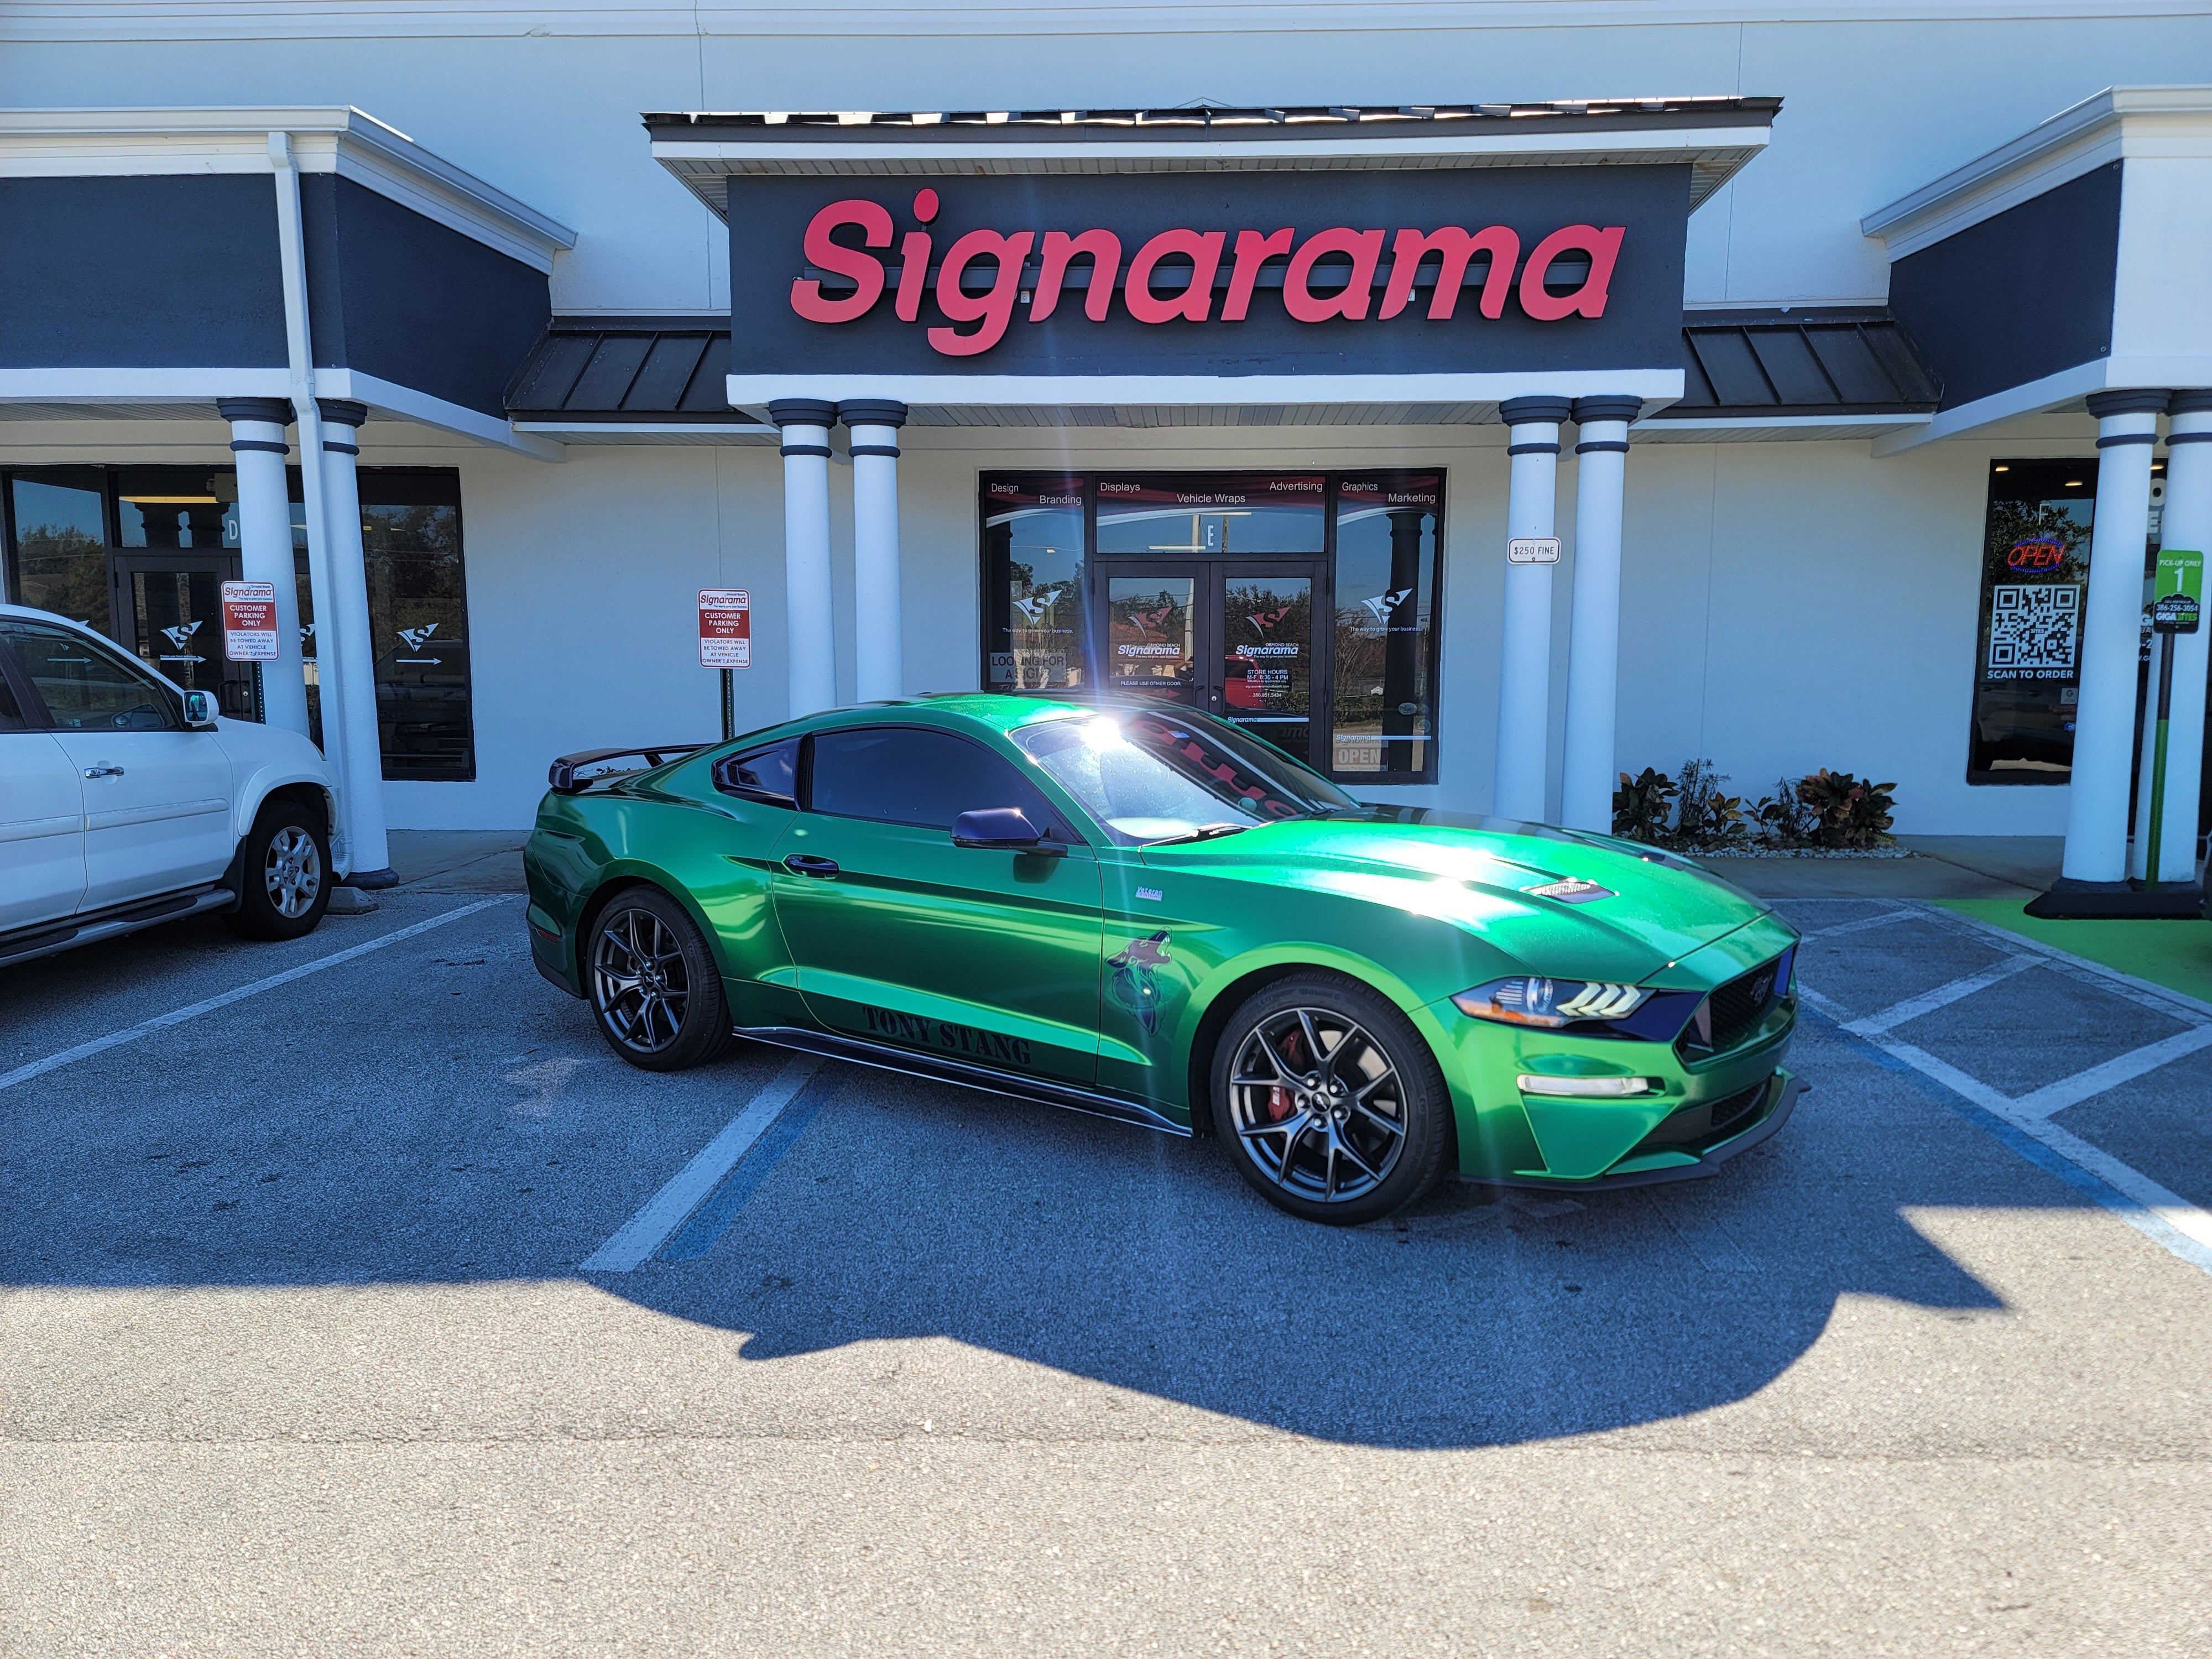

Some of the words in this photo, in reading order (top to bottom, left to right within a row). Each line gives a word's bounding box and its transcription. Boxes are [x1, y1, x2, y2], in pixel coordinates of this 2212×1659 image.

[790, 187, 1626, 356] Signarama
[991, 483, 1019, 494] Design
[1100, 482, 1141, 493] Displays
[1269, 481, 1323, 493] Advertising
[1342, 482, 1379, 493] Graphics
[1039, 495, 1082, 506] Branding
[1177, 494, 1212, 503] Vehicle
[1214, 494, 1246, 505] Wraps
[1388, 493, 1436, 504] Marketing
[2038, 503, 2051, 525] F
[228, 520, 238, 540] D
[1207, 525, 1214, 546] E
[1514, 546, 1535, 555] $250
[1538, 546, 1554, 555] FINE
[2007, 545, 2065, 566] OPEN
[2174, 567, 2183, 592] 1
[225, 587, 272, 598] Signarama
[700, 595, 746, 606] Signarama
[2156, 612, 2176, 621] GIGA
[1118, 644, 1180, 657] Signarama
[1235, 644, 1298, 657] Signarama
[1043, 656, 1064, 666] FOR
[1005, 669, 1013, 679] A
[1987, 670, 2017, 679] SCAN
[2019, 670, 2034, 679] TO
[2036, 670, 2074, 679] ORDER
[1338, 748, 1380, 764] OPEN
[1137, 885, 1163, 896] Veteran
[862, 1005, 932, 1044] TONY
[940, 1023, 1031, 1065] STANG
